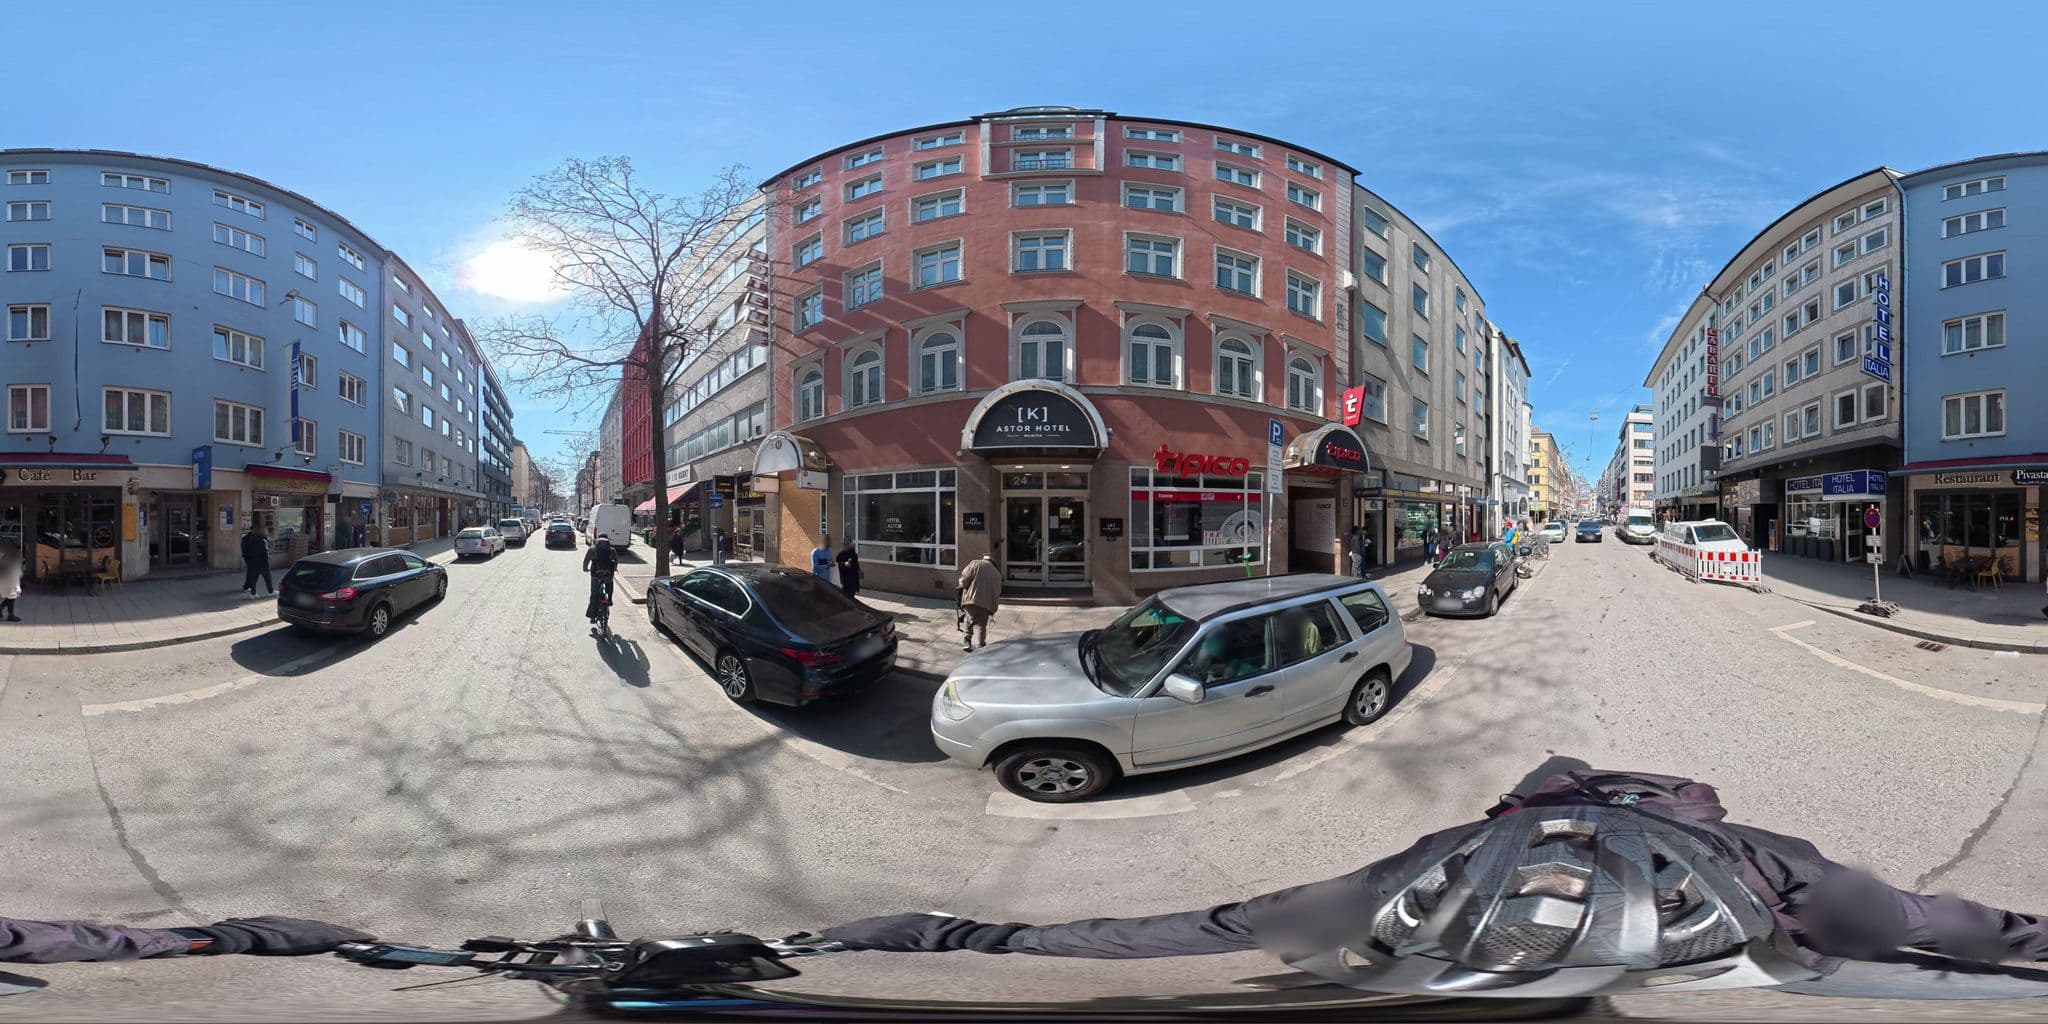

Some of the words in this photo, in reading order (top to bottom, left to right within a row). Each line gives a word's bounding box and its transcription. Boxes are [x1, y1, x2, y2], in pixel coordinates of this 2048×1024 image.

[1878, 276, 1889, 361] HOTEL
[1708, 328, 1717, 396] CABARET
[1864, 359, 1889, 379] ITALIA
[291, 356, 299, 391] HOTEL
[1035, 424, 1071, 432] HOTEL
[1272, 423, 1281, 442] P
[1153, 443, 1249, 479] tipico
[18, 468, 51, 481] Café
[72, 469, 97, 482] Bar
[1014, 476, 1027, 486] 24
[1831, 473, 1856, 484] HOTEL
[1935, 472, 2001, 484] Restaurant
[1789, 480, 1811, 490] HOTEL
[1832, 484, 1855, 494] ITALIA
